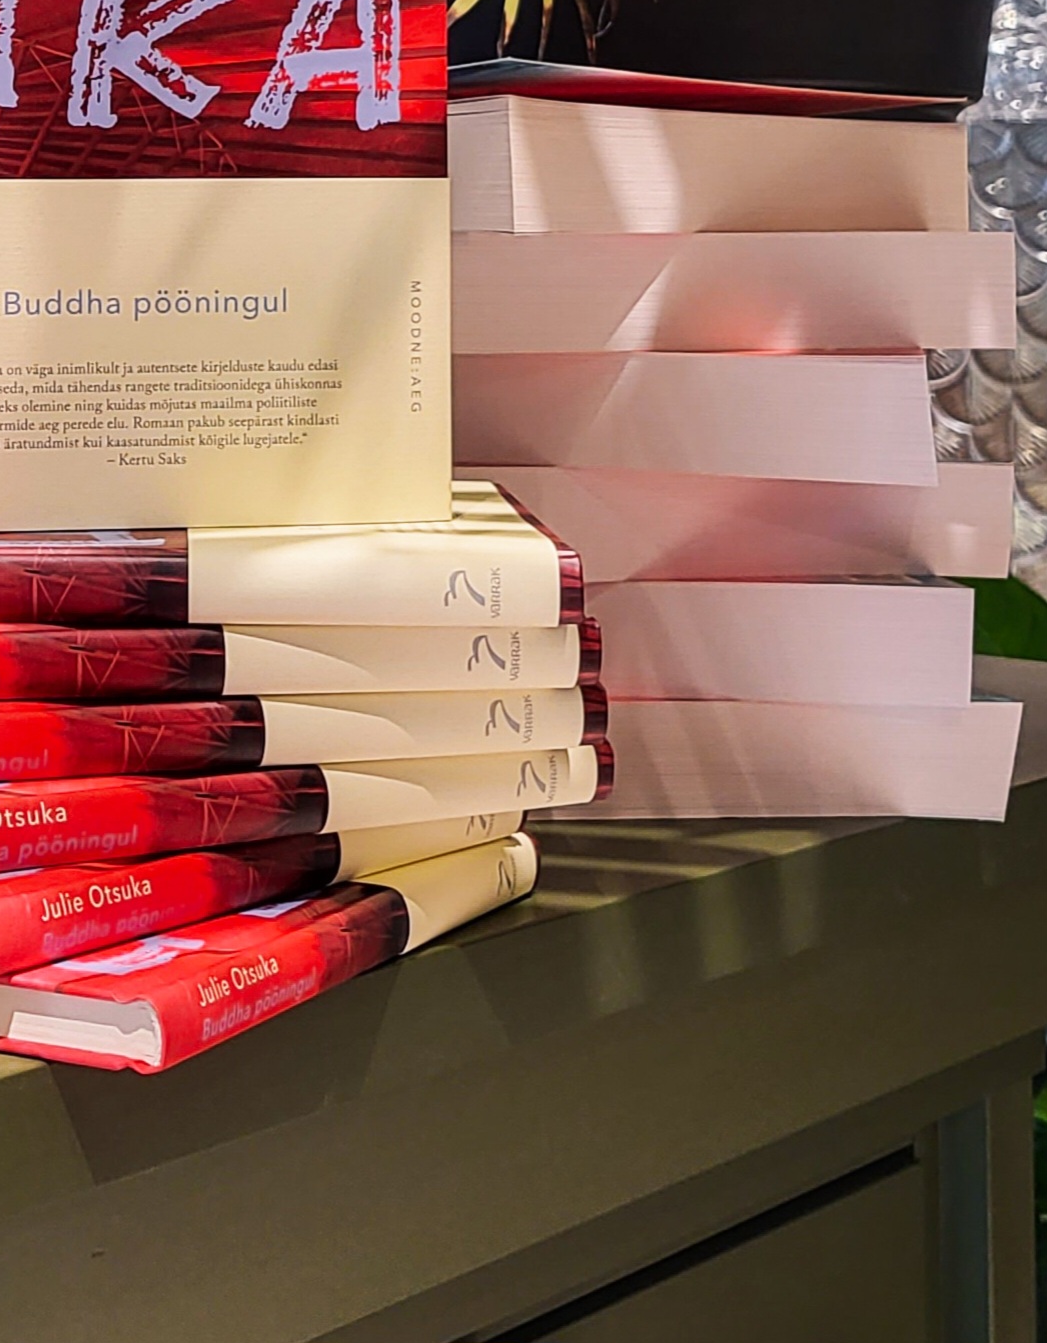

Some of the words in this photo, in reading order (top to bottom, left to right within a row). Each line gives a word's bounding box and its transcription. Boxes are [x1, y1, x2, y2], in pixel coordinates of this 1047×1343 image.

[3, 290, 122, 317] Buddha
[133, 287, 289, 321] pööningul
[6, 366, 22, 376] on
[25, 364, 53, 378] väga
[57, 362, 120, 375] inimlikult
[121, 362, 134, 377] ja
[201, 360, 265, 376] kirjelduste
[267, 359, 305, 372] kaudu
[308, 359, 338, 371] edasi
[32, 381, 64, 394] mida
[67, 380, 122, 393] tähendas
[125, 382, 170, 395] rangete
[174, 378, 272, 394] traditsioonidega
[274, 377, 343, 390] ühiskonnas
[21, 399, 71, 412] olemine
[74, 399, 104, 414] ning
[106, 398, 147, 411] kuidas
[149, 398, 197, 413] mõjutas
[200, 396, 253, 409] maailma
[256, 396, 318, 412] poliitiliste
[38, 421, 60, 434] aeg
[63, 418, 104, 434] perede
[106, 417, 129, 429] elu.
[133, 416, 184, 429] Romaan
[188, 415, 226, 431] pakub
[228, 415, 284, 430] seepärast
[287, 414, 339, 426] kindlasti
[4, 436, 79, 450] äratundmist
[83, 435, 102, 448] kui
[106, 434, 195, 448] kaasatundmist
[198, 433, 240, 450] kõigile
[119, 453, 155, 466] Kertu
[158, 452, 187, 466] Saks
[18, 826, 139, 863] pööningul
[41, 892, 84, 922] Julie
[88, 875, 152, 908] Otsuka
[197, 976, 231, 1007] Julie
[232, 955, 280, 993] Otsuka
[202, 1002, 251, 1042] Buddha
[253, 968, 317, 1019] pööningul
